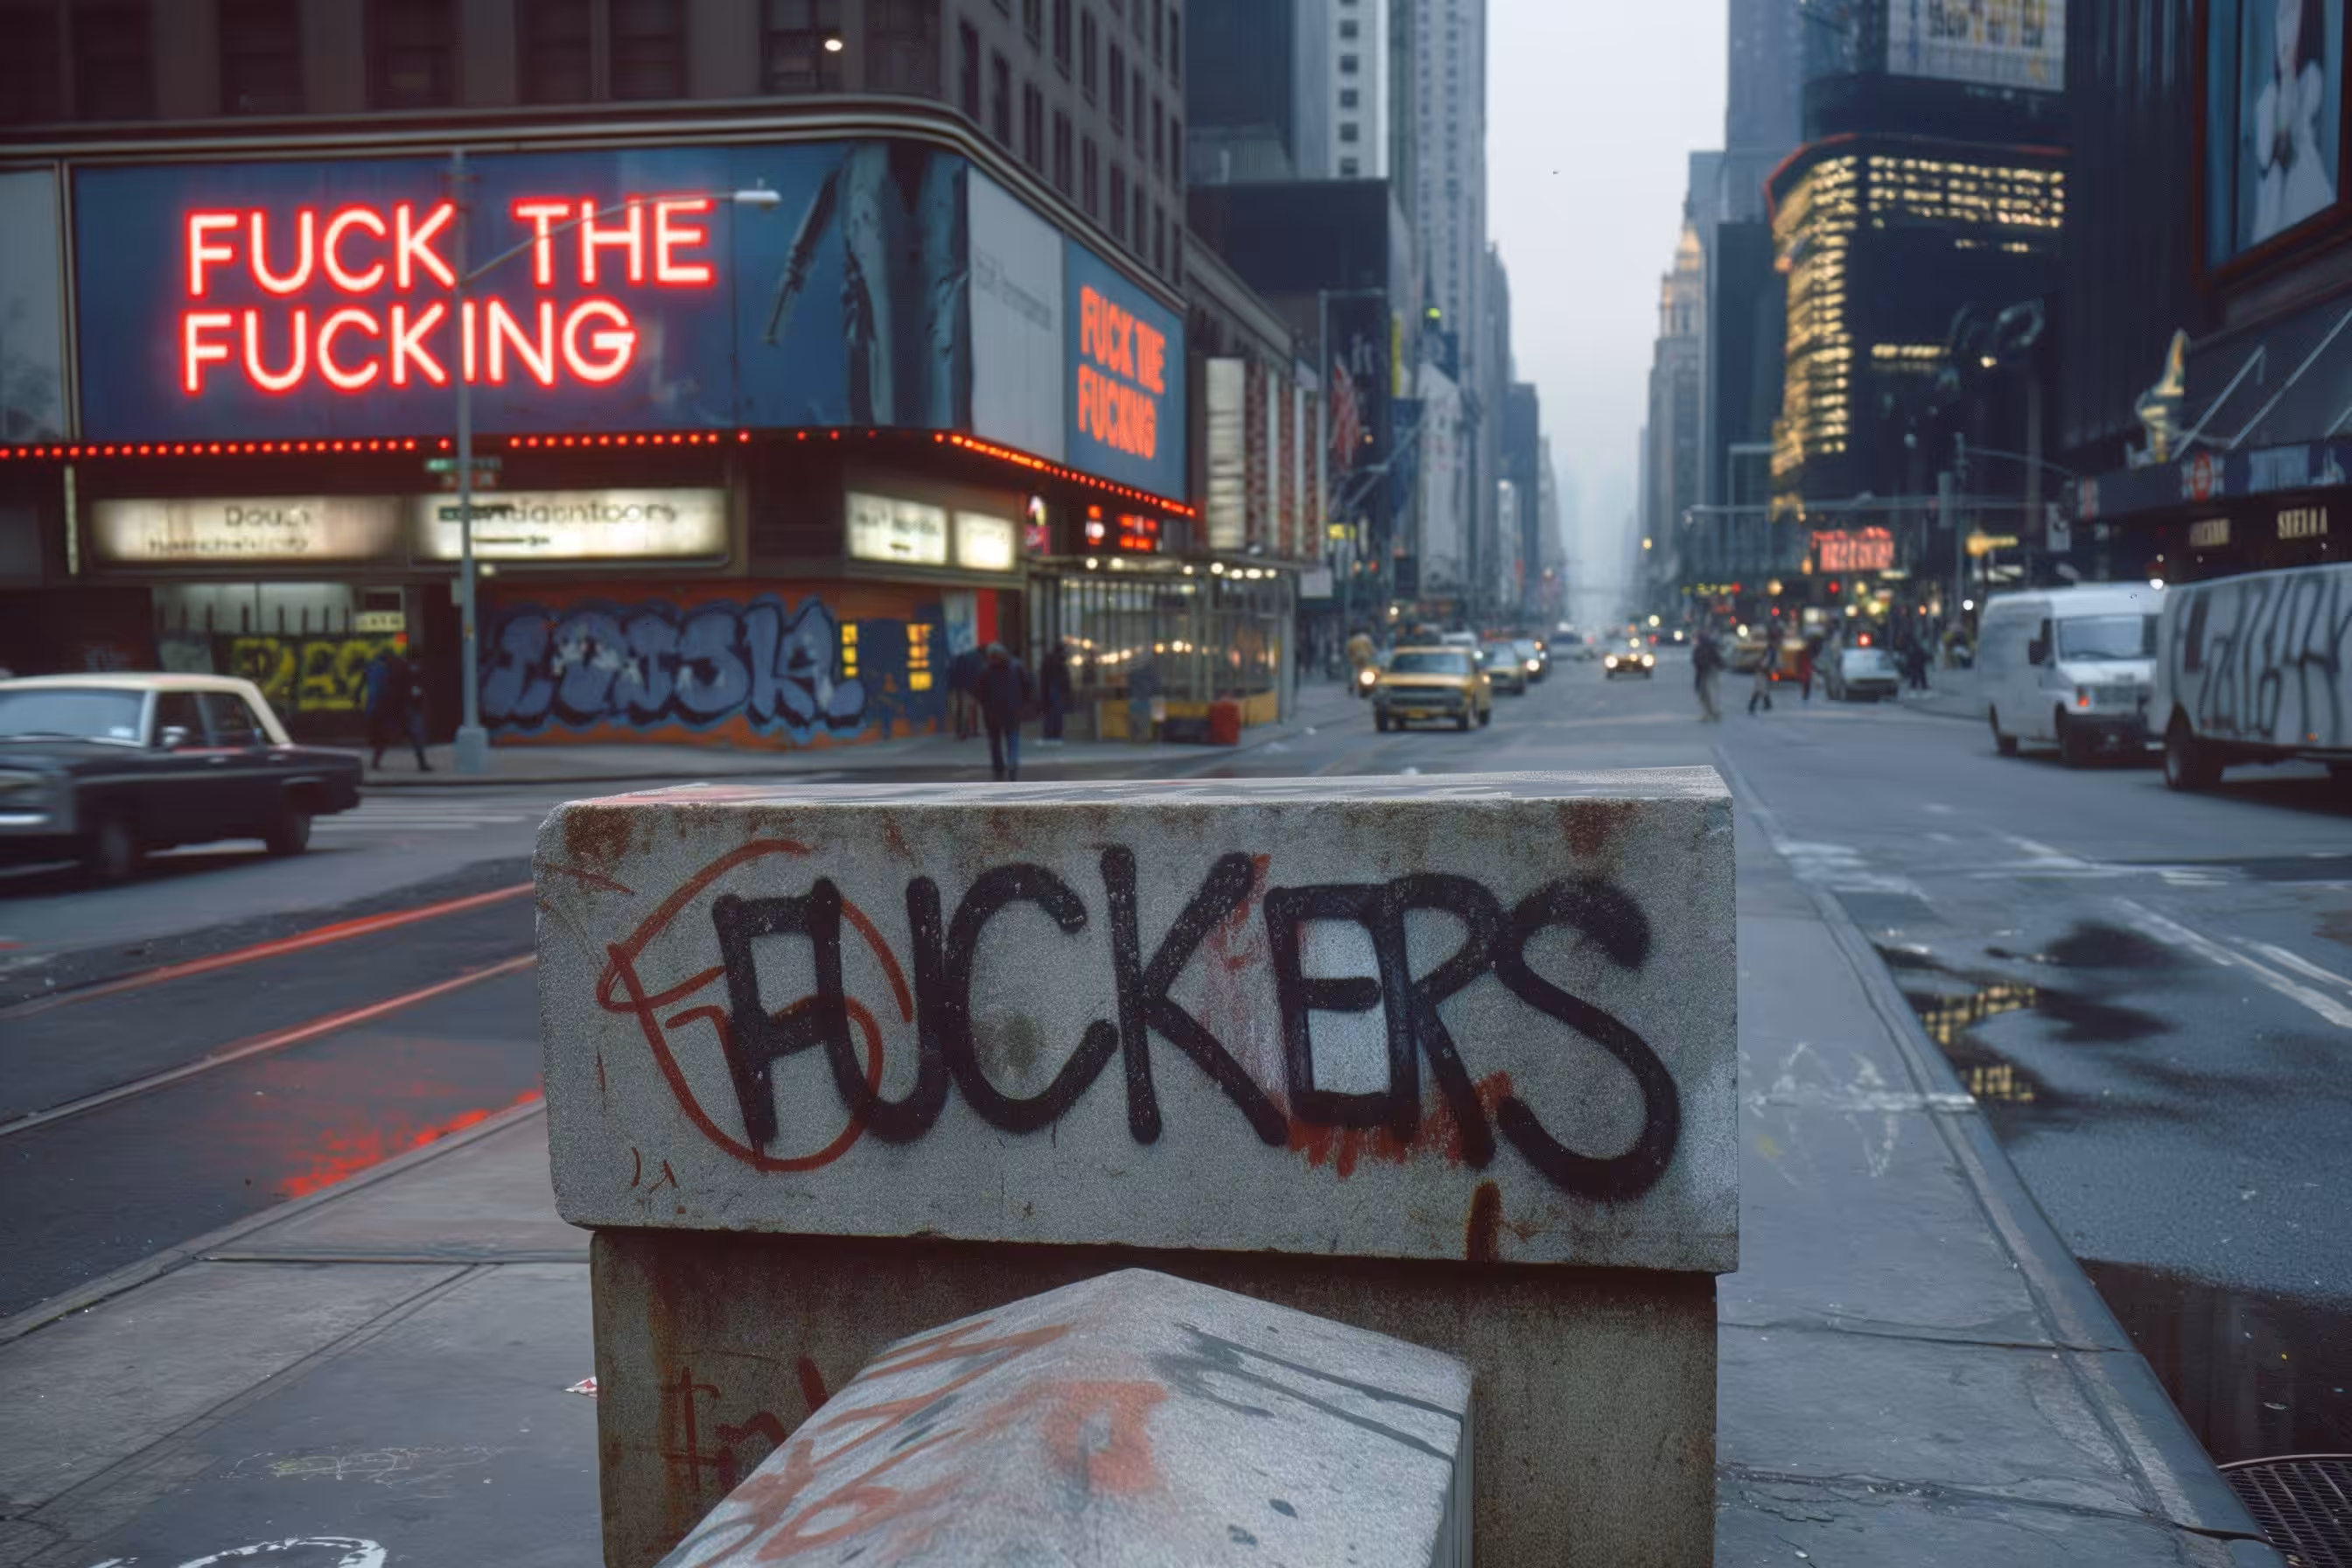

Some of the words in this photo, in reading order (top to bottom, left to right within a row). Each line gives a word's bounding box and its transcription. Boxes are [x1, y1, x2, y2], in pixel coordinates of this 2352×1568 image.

[185, 200, 457, 299] FUCK
[511, 195, 714, 290] THE
[181, 294, 640, 396] FUCKING
[1081, 284, 1135, 379] FUCK
[712, 843, 1682, 1202] FUCKERS
